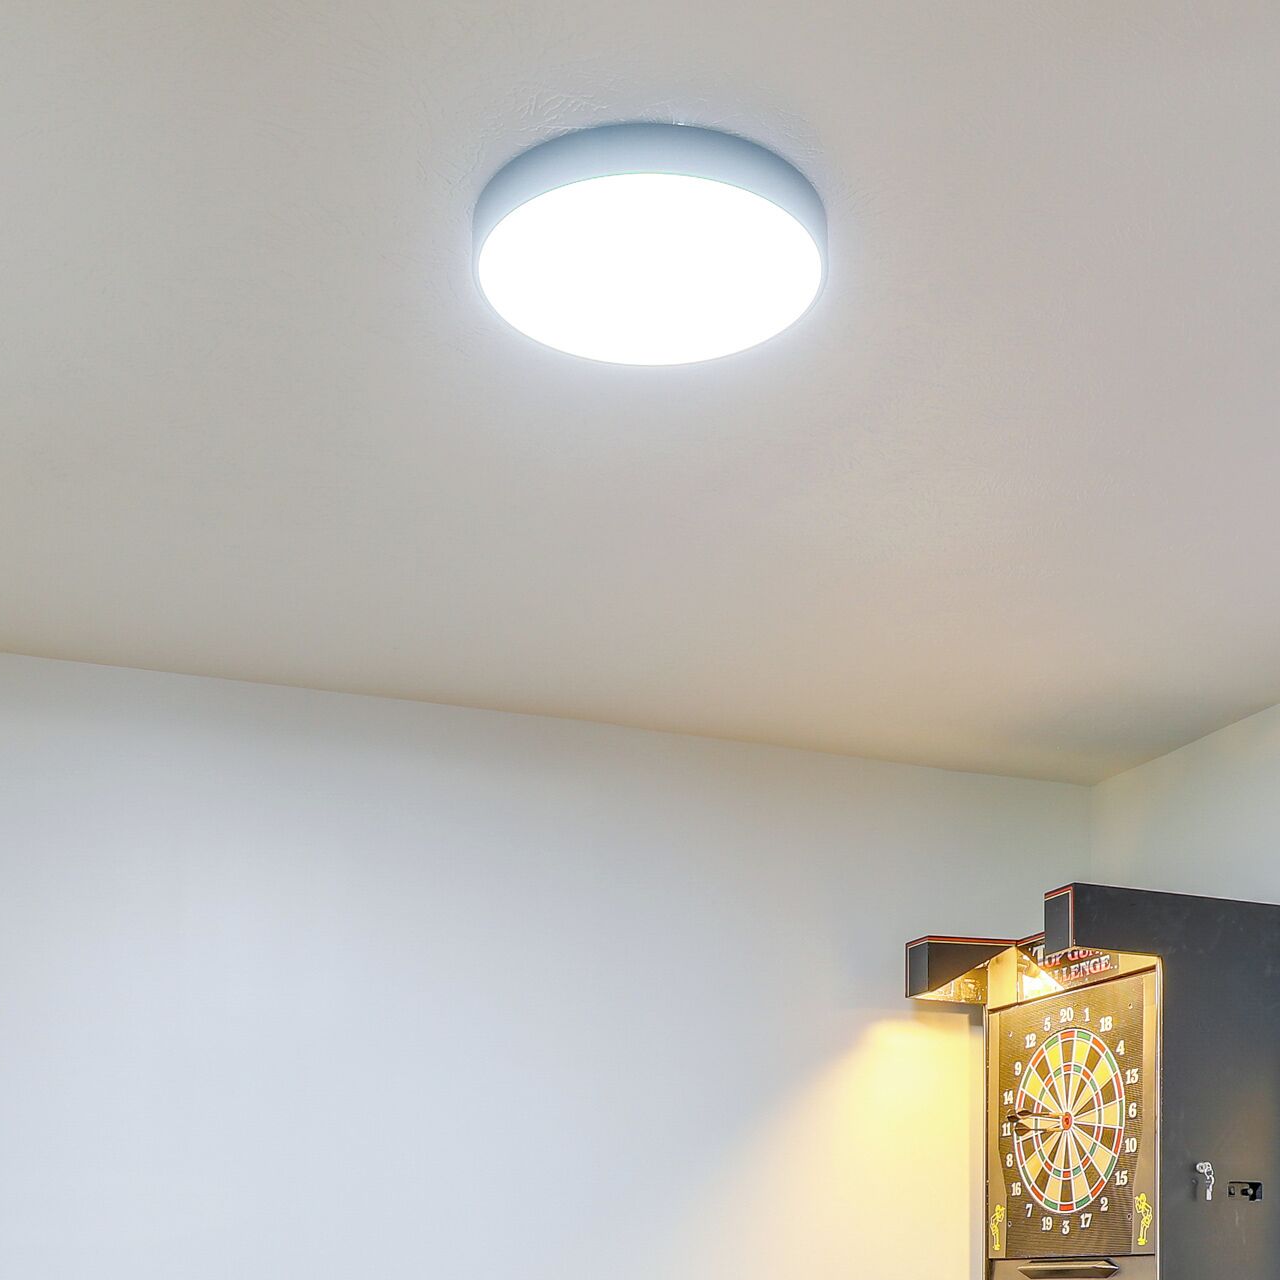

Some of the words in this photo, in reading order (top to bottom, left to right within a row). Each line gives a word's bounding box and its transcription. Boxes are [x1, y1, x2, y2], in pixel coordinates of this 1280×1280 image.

[1051, 955, 1111, 982] LLENGE
[1060, 1007, 1073, 1022] 20
[1084, 1008, 1090, 1021] 1
[1044, 1017, 1051, 1031] 5
[1100, 1016, 1112, 1032] 18
[1025, 1034, 1036, 1048] 12
[1116, 1040, 1125, 1055] 4
[1015, 1062, 1021, 1075] 9
[1126, 1069, 1139, 1084] 13
[1003, 1090, 1013, 1104] 14
[1129, 1103, 1136, 1117] 6
[1002, 1123, 1011, 1136] 11
[1125, 1138, 1137, 1152] 10
[1006, 1154, 1013, 1167] 8
[1115, 1171, 1128, 1185] 15
[1011, 1183, 1021, 1195] 16
[1026, 1204, 1032, 1217] 7
[1100, 1198, 1108, 1211] 2
[1042, 1217, 1052, 1230] 19
[1062, 1221, 1069, 1234] 3
[1080, 1214, 1092, 1228] 17
